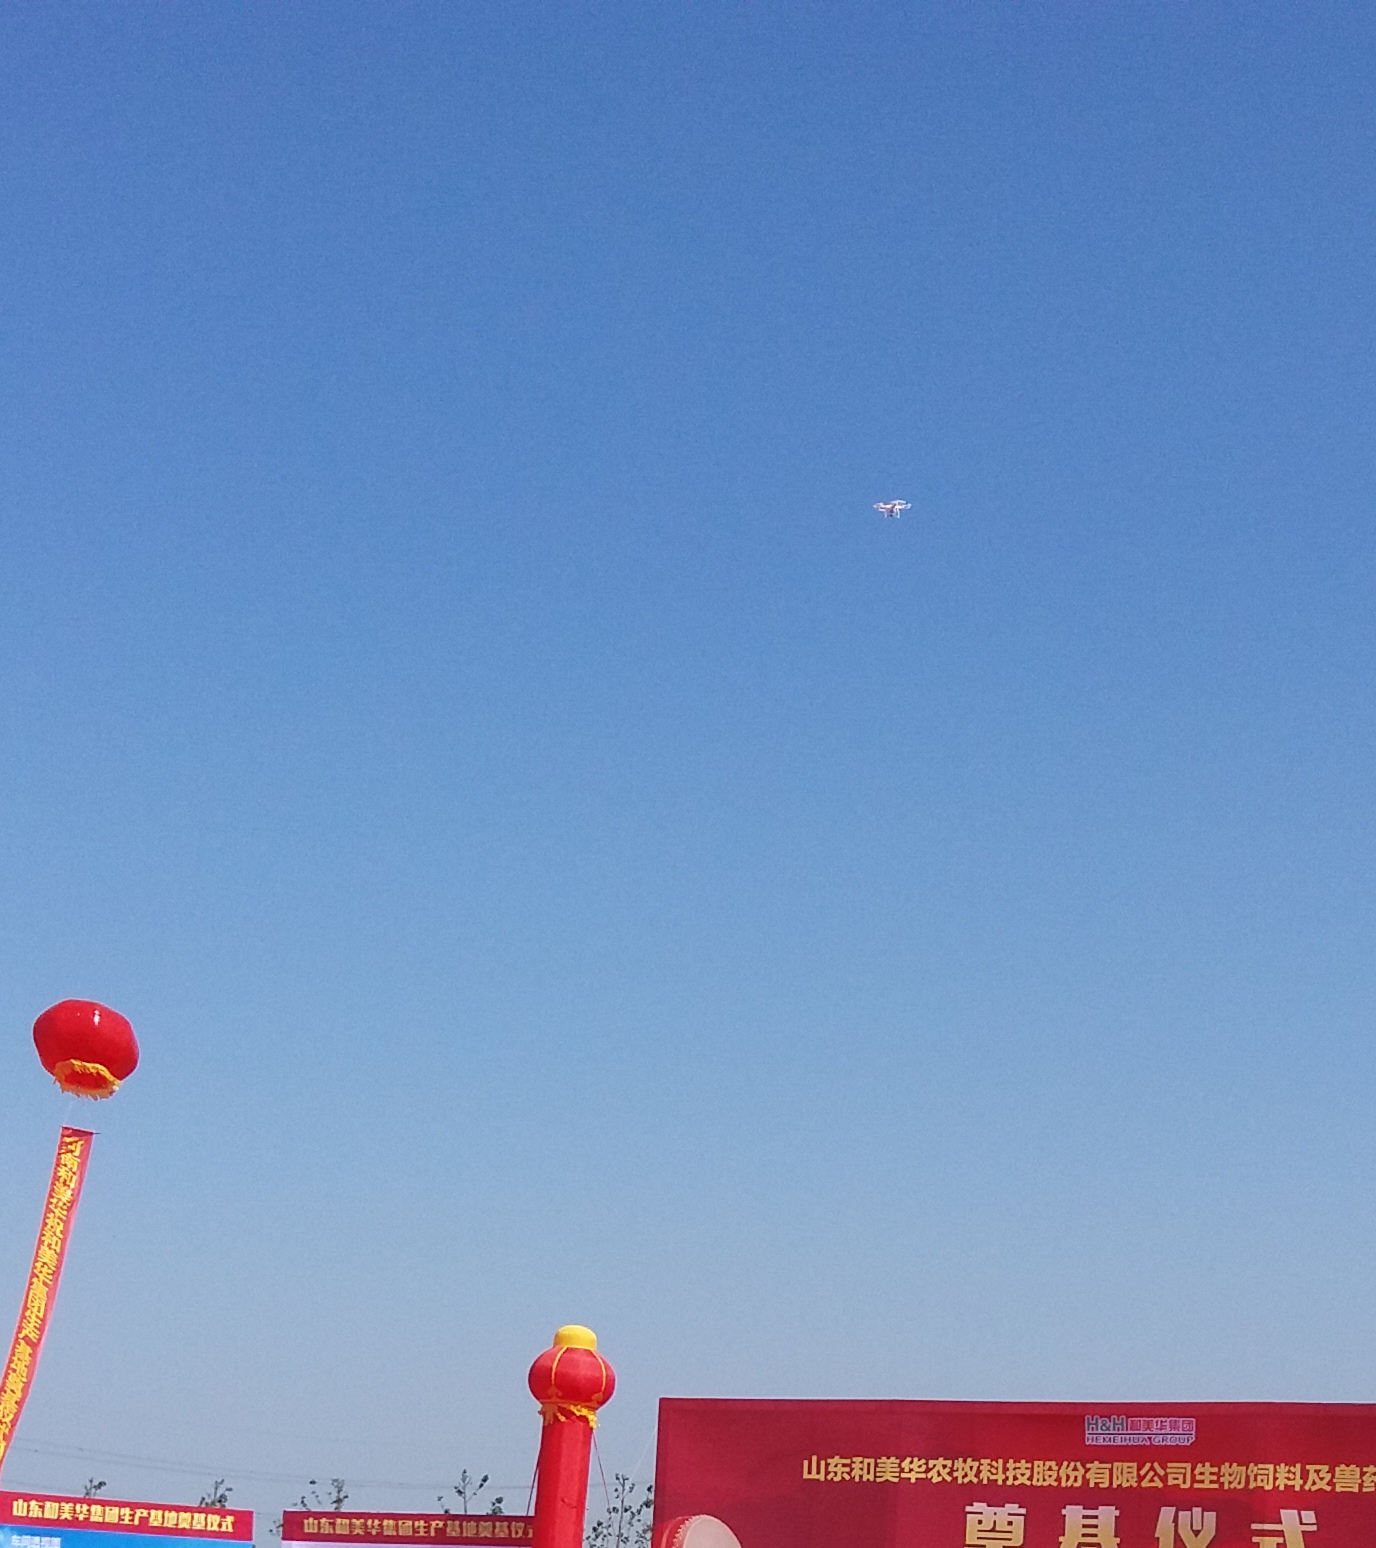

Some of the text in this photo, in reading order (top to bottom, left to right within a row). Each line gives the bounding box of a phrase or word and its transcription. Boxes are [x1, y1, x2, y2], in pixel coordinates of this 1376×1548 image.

[1085, 1416, 1126, 1432] H&H
[1086, 1434, 1195, 1445] HEMEIHUA GROUP
[12, 1498, 235, 1533] 山东和美华集团生产基地奠基仪式
